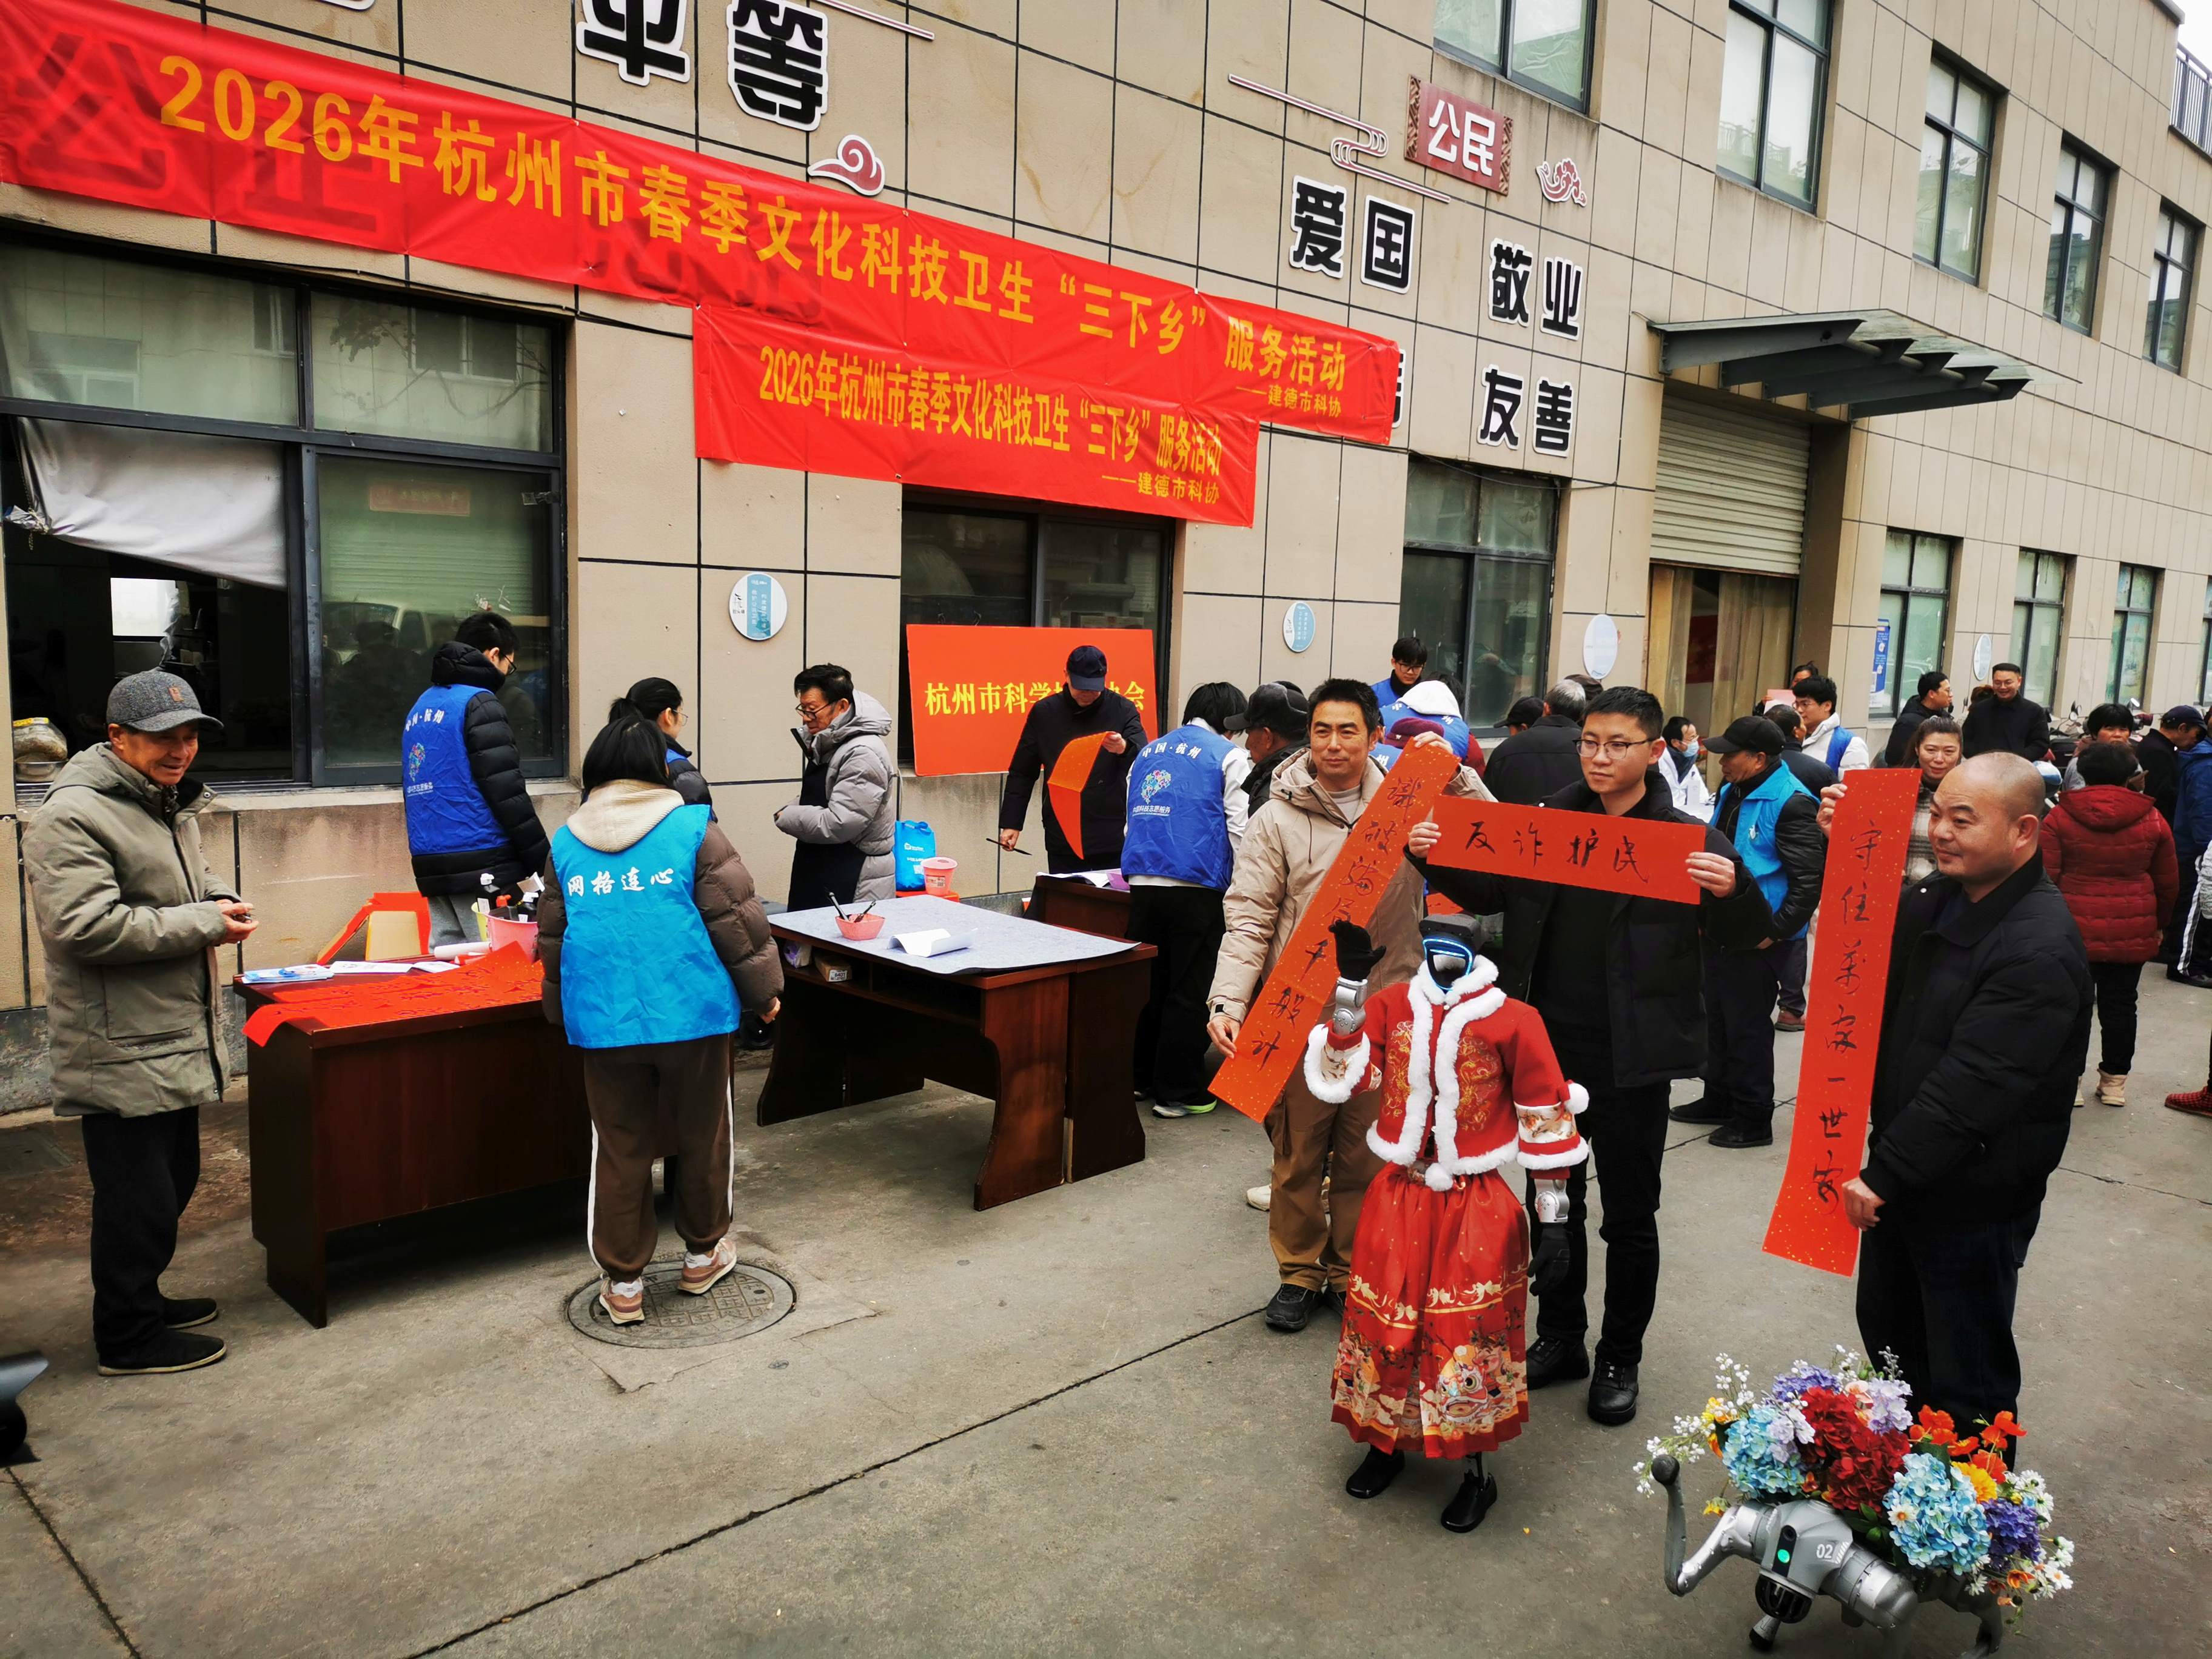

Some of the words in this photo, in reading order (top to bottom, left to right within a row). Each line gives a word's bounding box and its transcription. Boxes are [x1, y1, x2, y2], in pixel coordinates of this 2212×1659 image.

[1429, 99, 1495, 176] 公民
[1293, 182, 1413, 288] 爱国
[1492, 243, 1581, 336] 敬业
[1480, 369, 1572, 451] 友善
[925, 681, 1145, 716] 杭州市科学会
[568, 866, 674, 897] 网格连心
[1465, 821, 1649, 883] 反诈护民
[1817, 1544, 1832, 1558] 02
